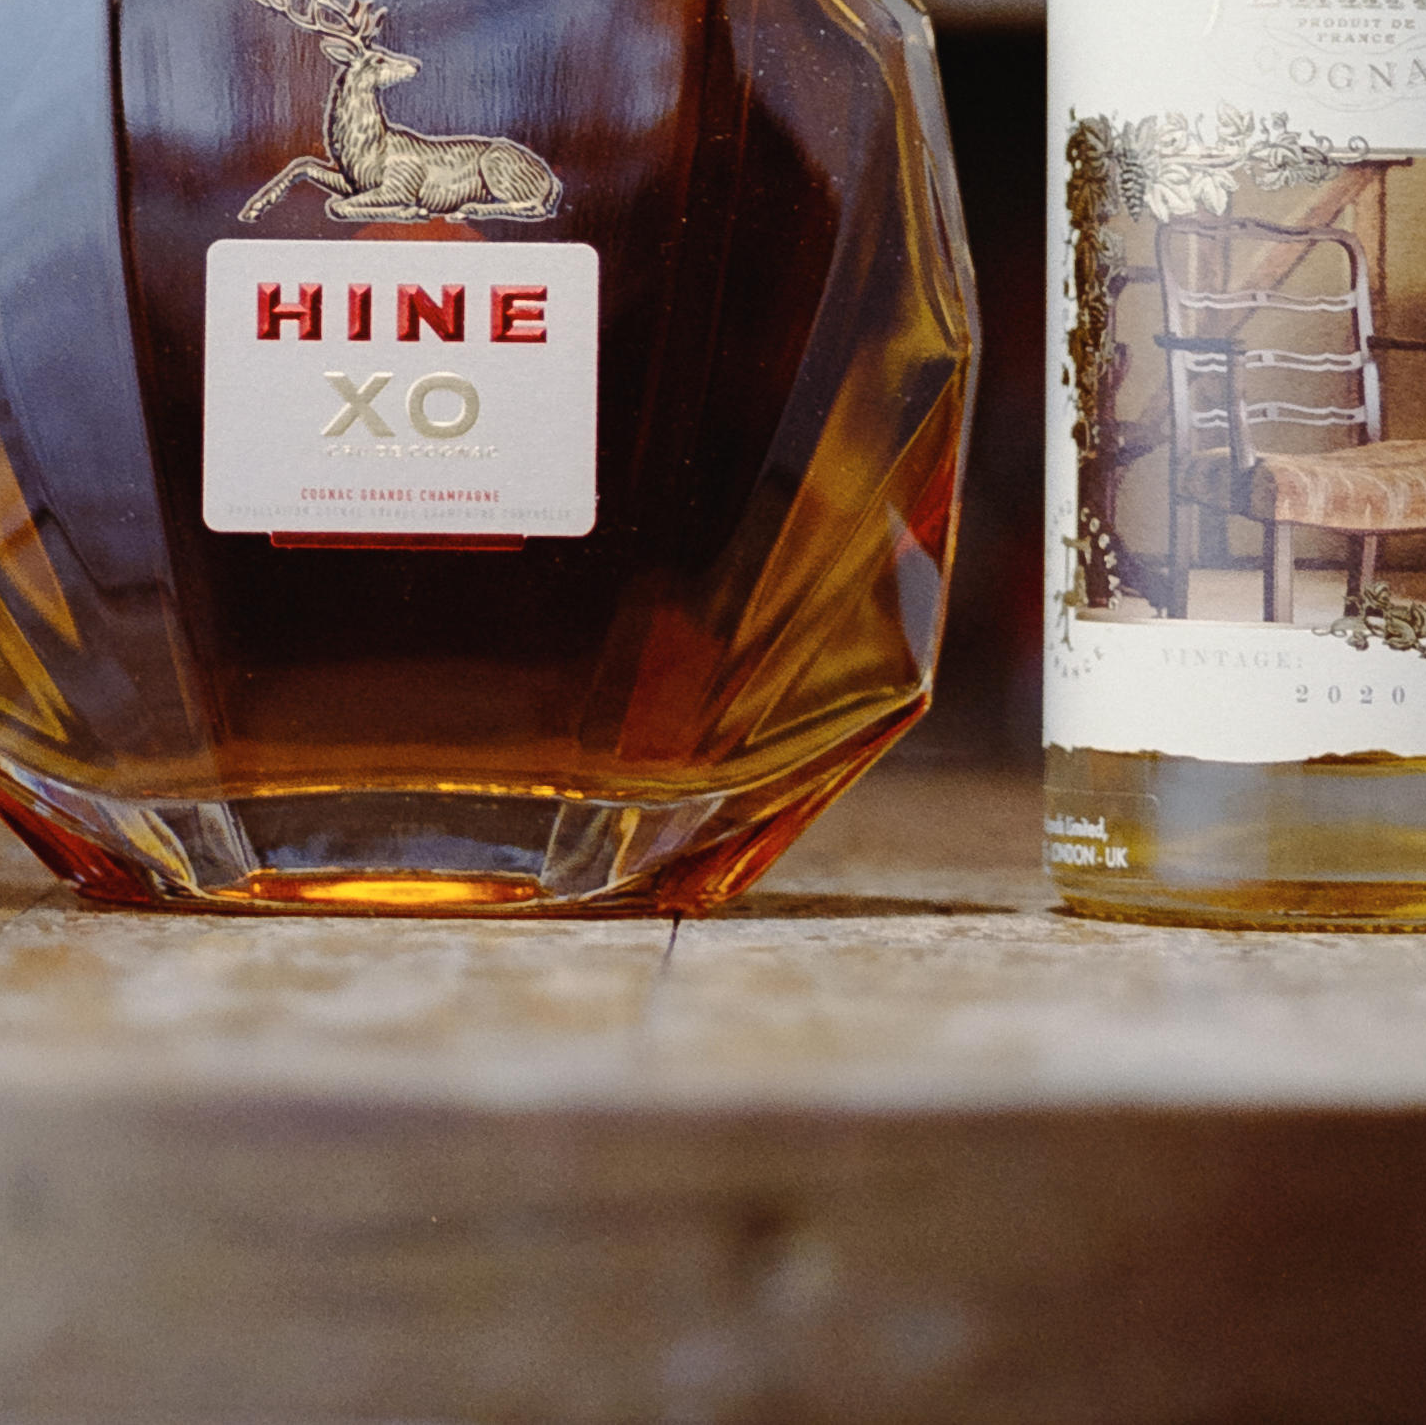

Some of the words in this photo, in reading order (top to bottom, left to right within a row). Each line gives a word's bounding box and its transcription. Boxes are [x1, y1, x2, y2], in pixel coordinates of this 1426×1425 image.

[1391, 18, 1417, 30] DE
[1316, 32, 1397, 45] FRANCE
[256, 282, 548, 343] HINE
[320, 370, 481, 440] XO
[300, 487, 354, 502] COGNAC
[360, 488, 414, 503] GRANDE
[419, 489, 501, 504] CHAMPAGNE
[1294, 683, 1407, 707] 2020
[1105, 846, 1129, 868] UK
